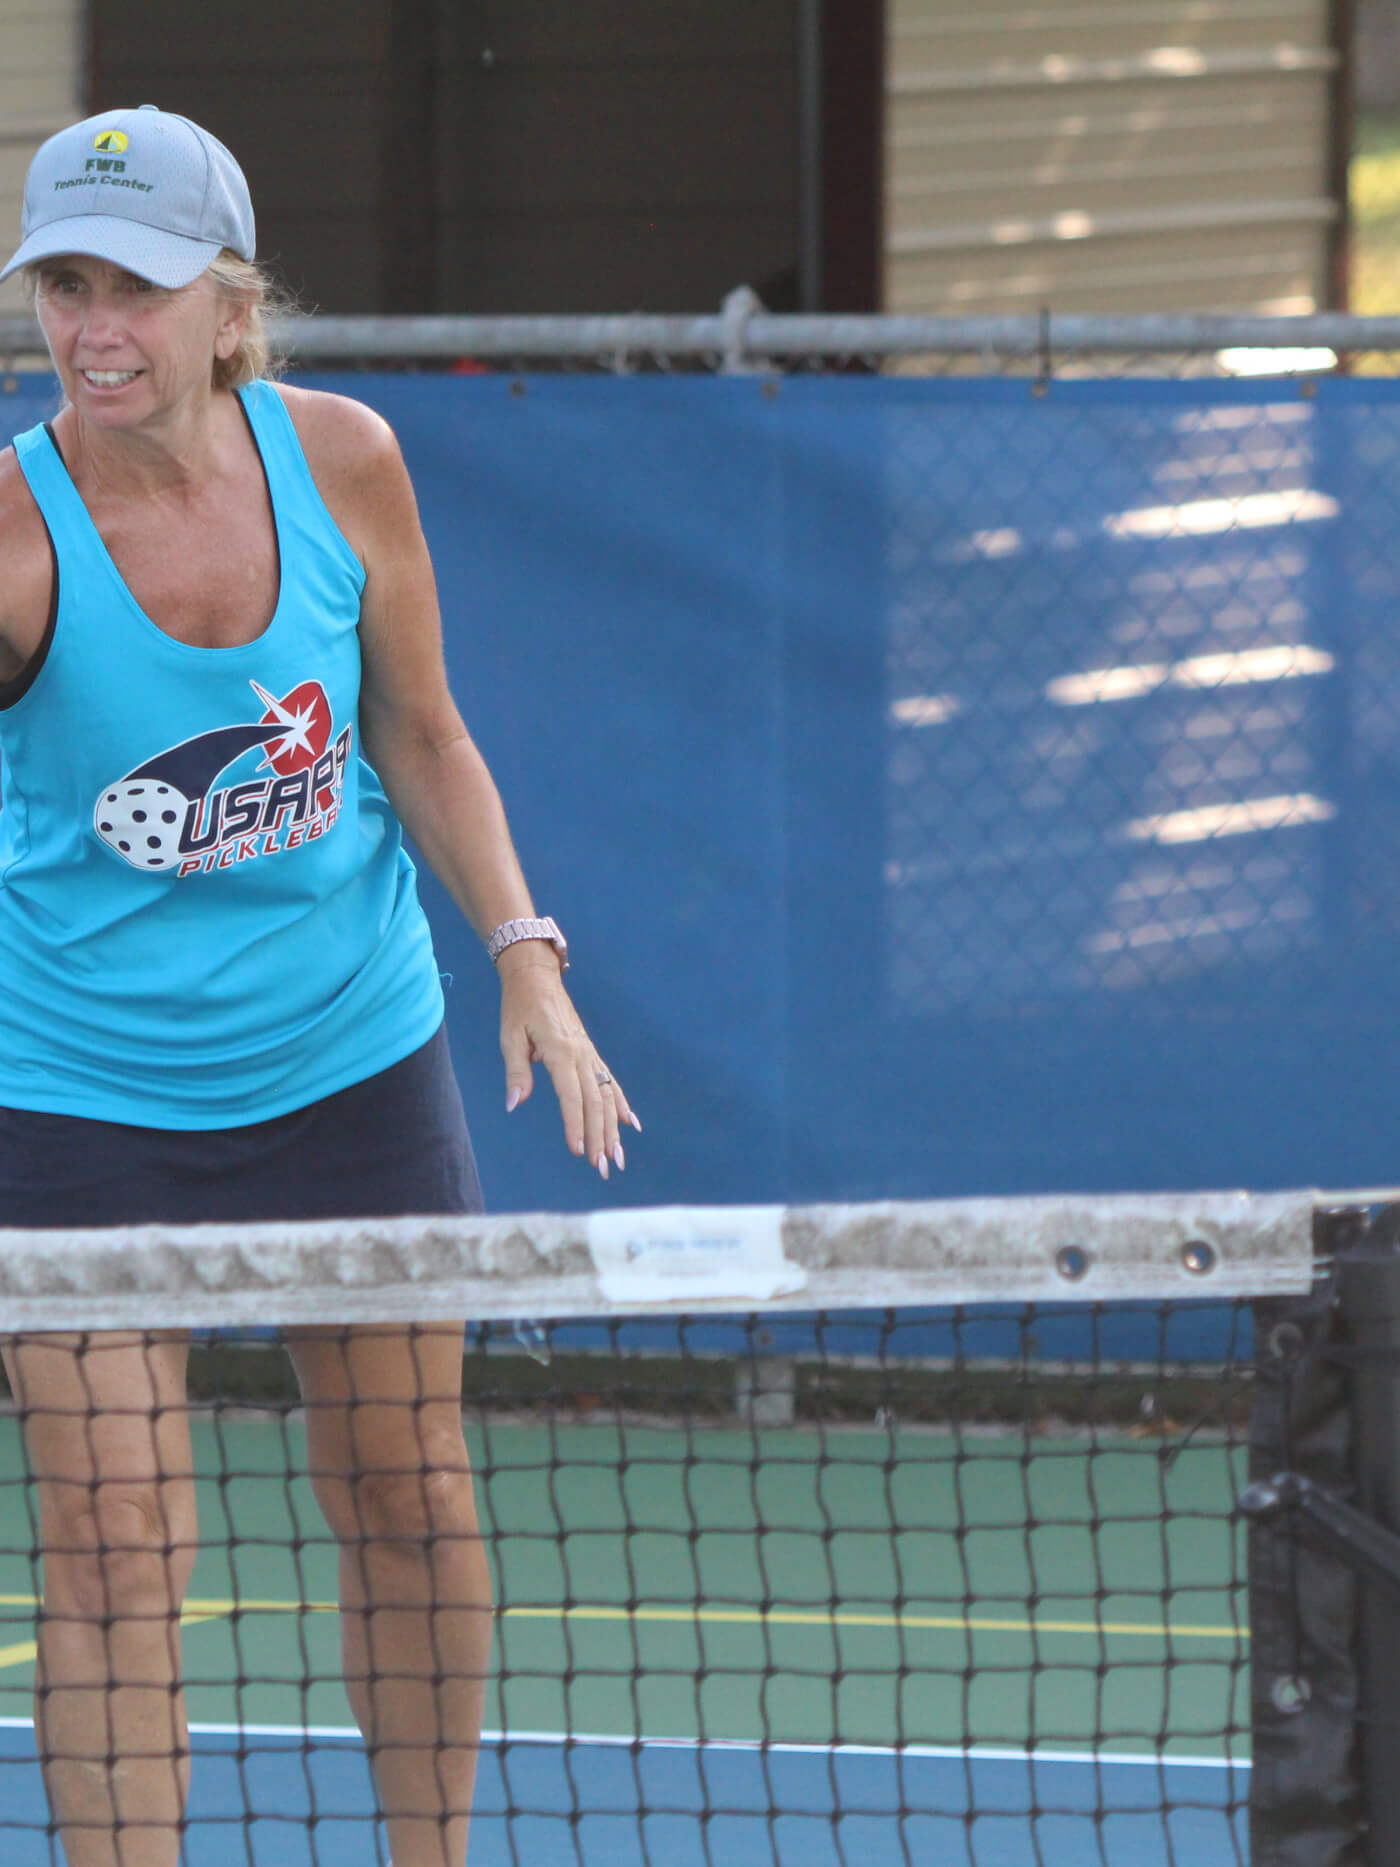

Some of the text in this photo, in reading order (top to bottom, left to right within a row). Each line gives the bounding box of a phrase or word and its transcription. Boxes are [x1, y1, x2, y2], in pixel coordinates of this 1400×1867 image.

[85, 158, 126, 173] FWB
[54, 174, 154, 193] Tennis Center
